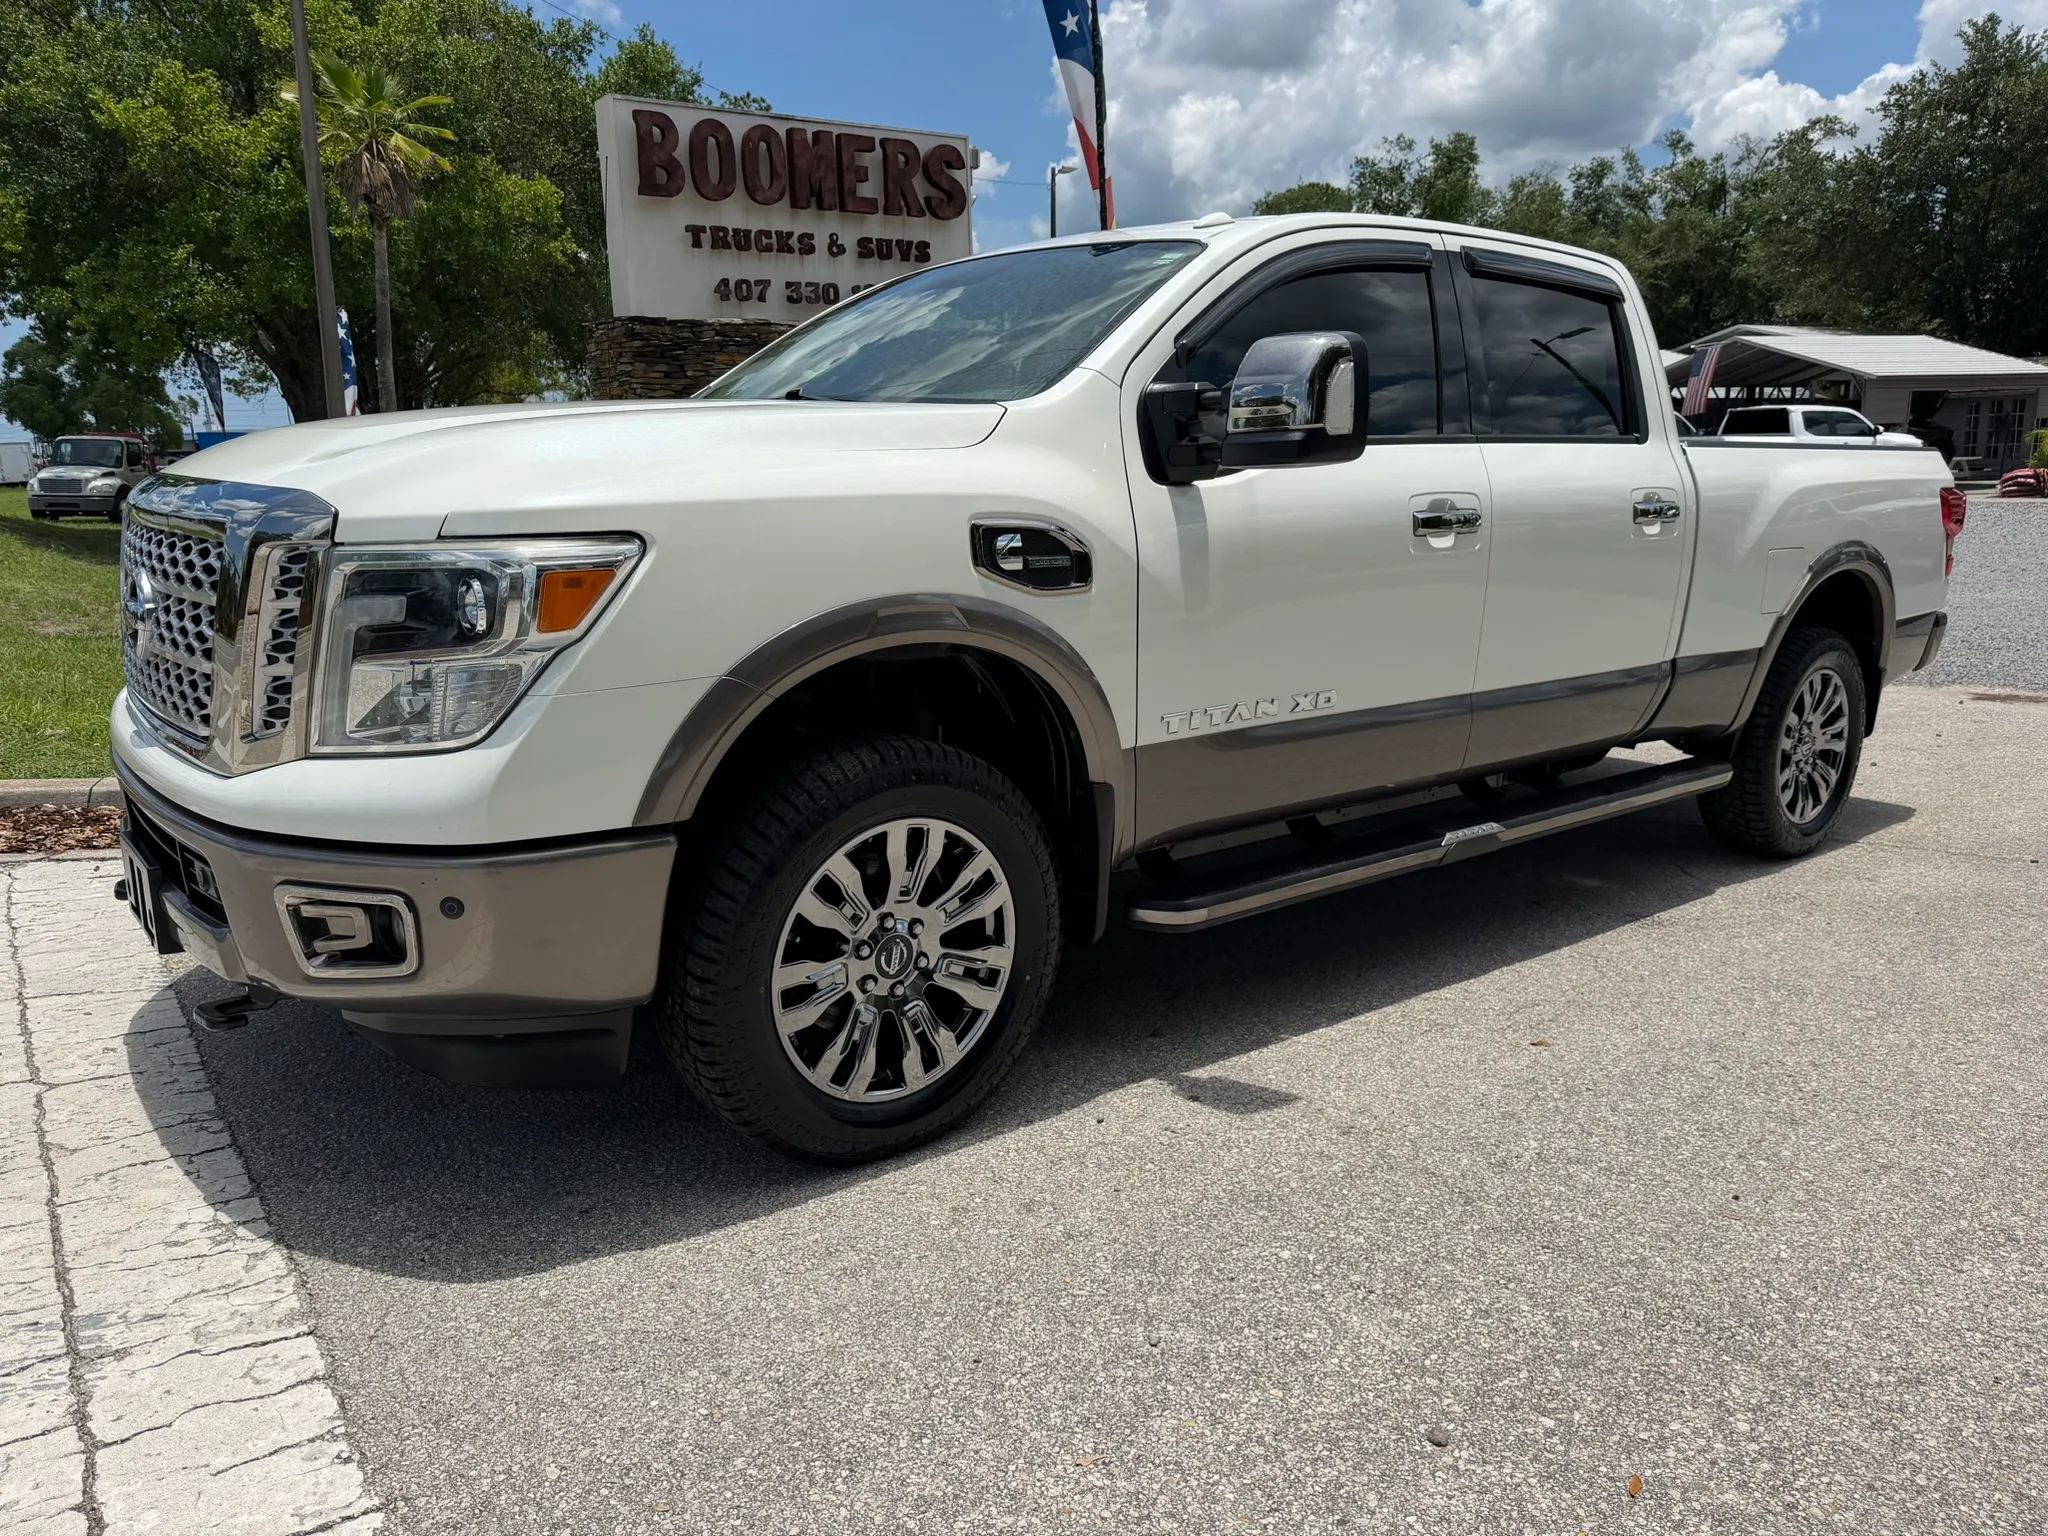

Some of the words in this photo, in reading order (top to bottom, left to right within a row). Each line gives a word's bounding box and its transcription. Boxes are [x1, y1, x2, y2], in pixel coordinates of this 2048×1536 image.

[632, 109, 967, 220] BOOMERS
[684, 224, 816, 256] TRUCKS
[827, 232, 846, 258] &
[857, 236, 931, 263] SUVS
[714, 277, 771, 303] 407
[785, 281, 840, 305] 330
[1160, 698, 1280, 734] TITAN
[1289, 689, 1338, 713] XD
